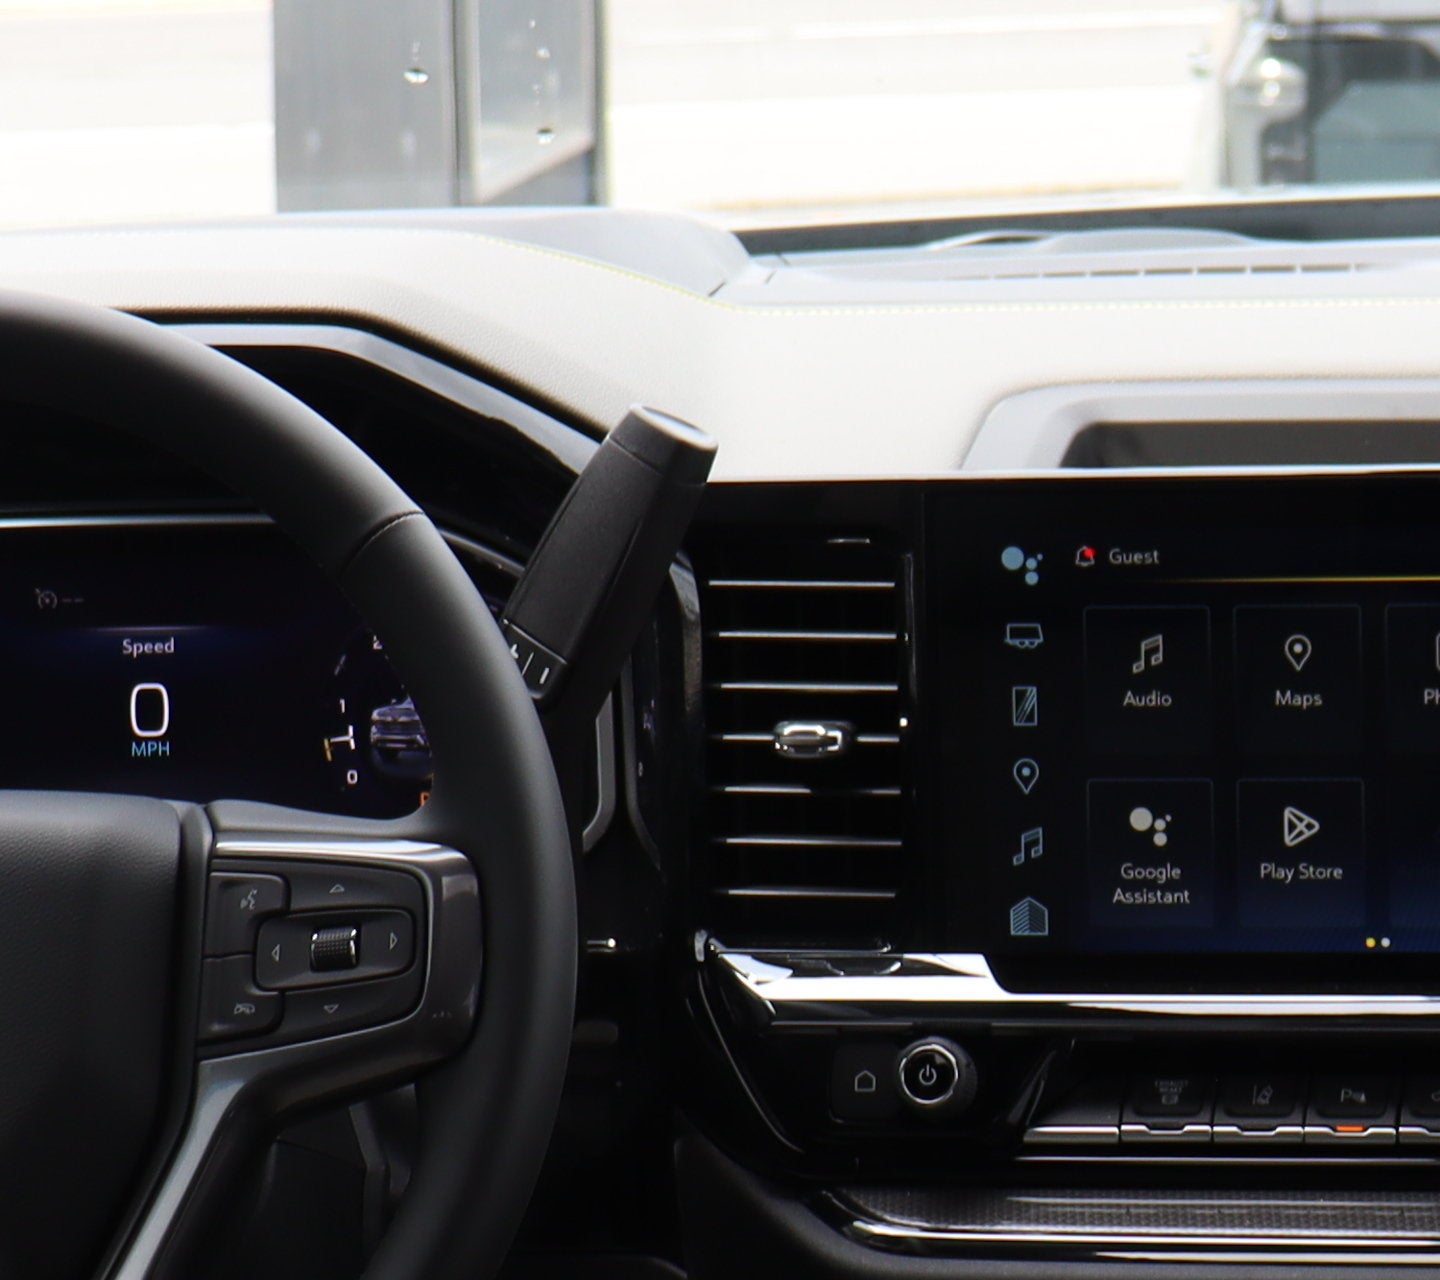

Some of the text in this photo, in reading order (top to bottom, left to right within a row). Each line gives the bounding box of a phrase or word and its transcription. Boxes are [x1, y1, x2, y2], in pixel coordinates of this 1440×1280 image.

[1109, 548, 1160, 566] Guest
[122, 637, 175, 658] Speed
[339, 698, 346, 714] 1
[1123, 689, 1172, 709] Audio
[1275, 690, 1323, 711] Maps
[130, 683, 170, 738] 0
[131, 741, 170, 757] MPH
[347, 770, 358, 785] 0
[1120, 863, 1182, 884] Google
[1260, 862, 1343, 883] Play Store
[1112, 887, 1191, 905] Assistant
